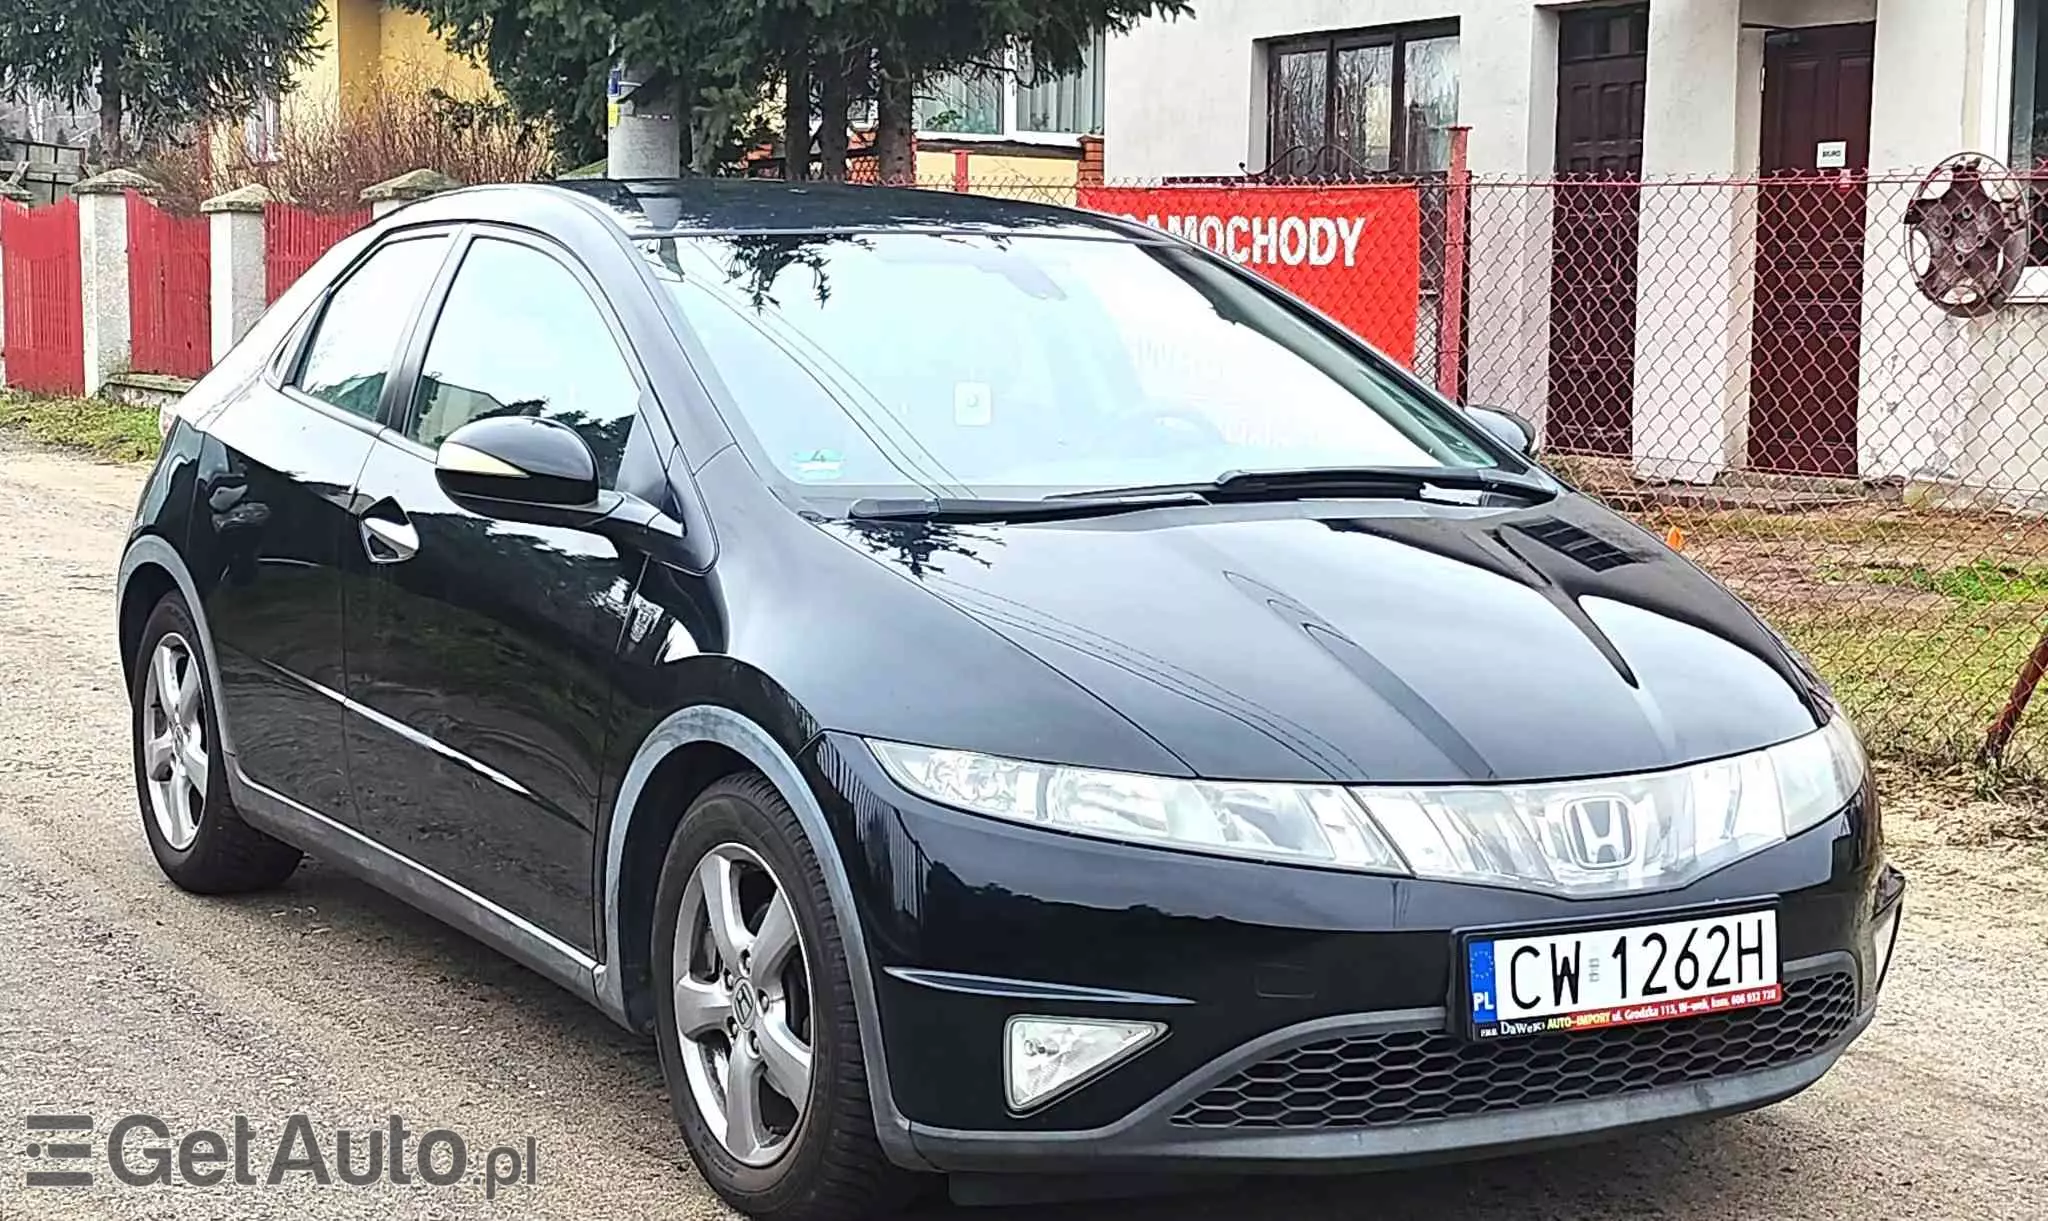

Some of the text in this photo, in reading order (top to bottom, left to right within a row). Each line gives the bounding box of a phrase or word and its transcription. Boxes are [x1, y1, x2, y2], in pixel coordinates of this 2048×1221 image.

[1510, 918, 1763, 1010] CW 1262H
[1472, 991, 1495, 1011] PL
[1547, 1012, 1610, 1030] AUTO-IMPORT
